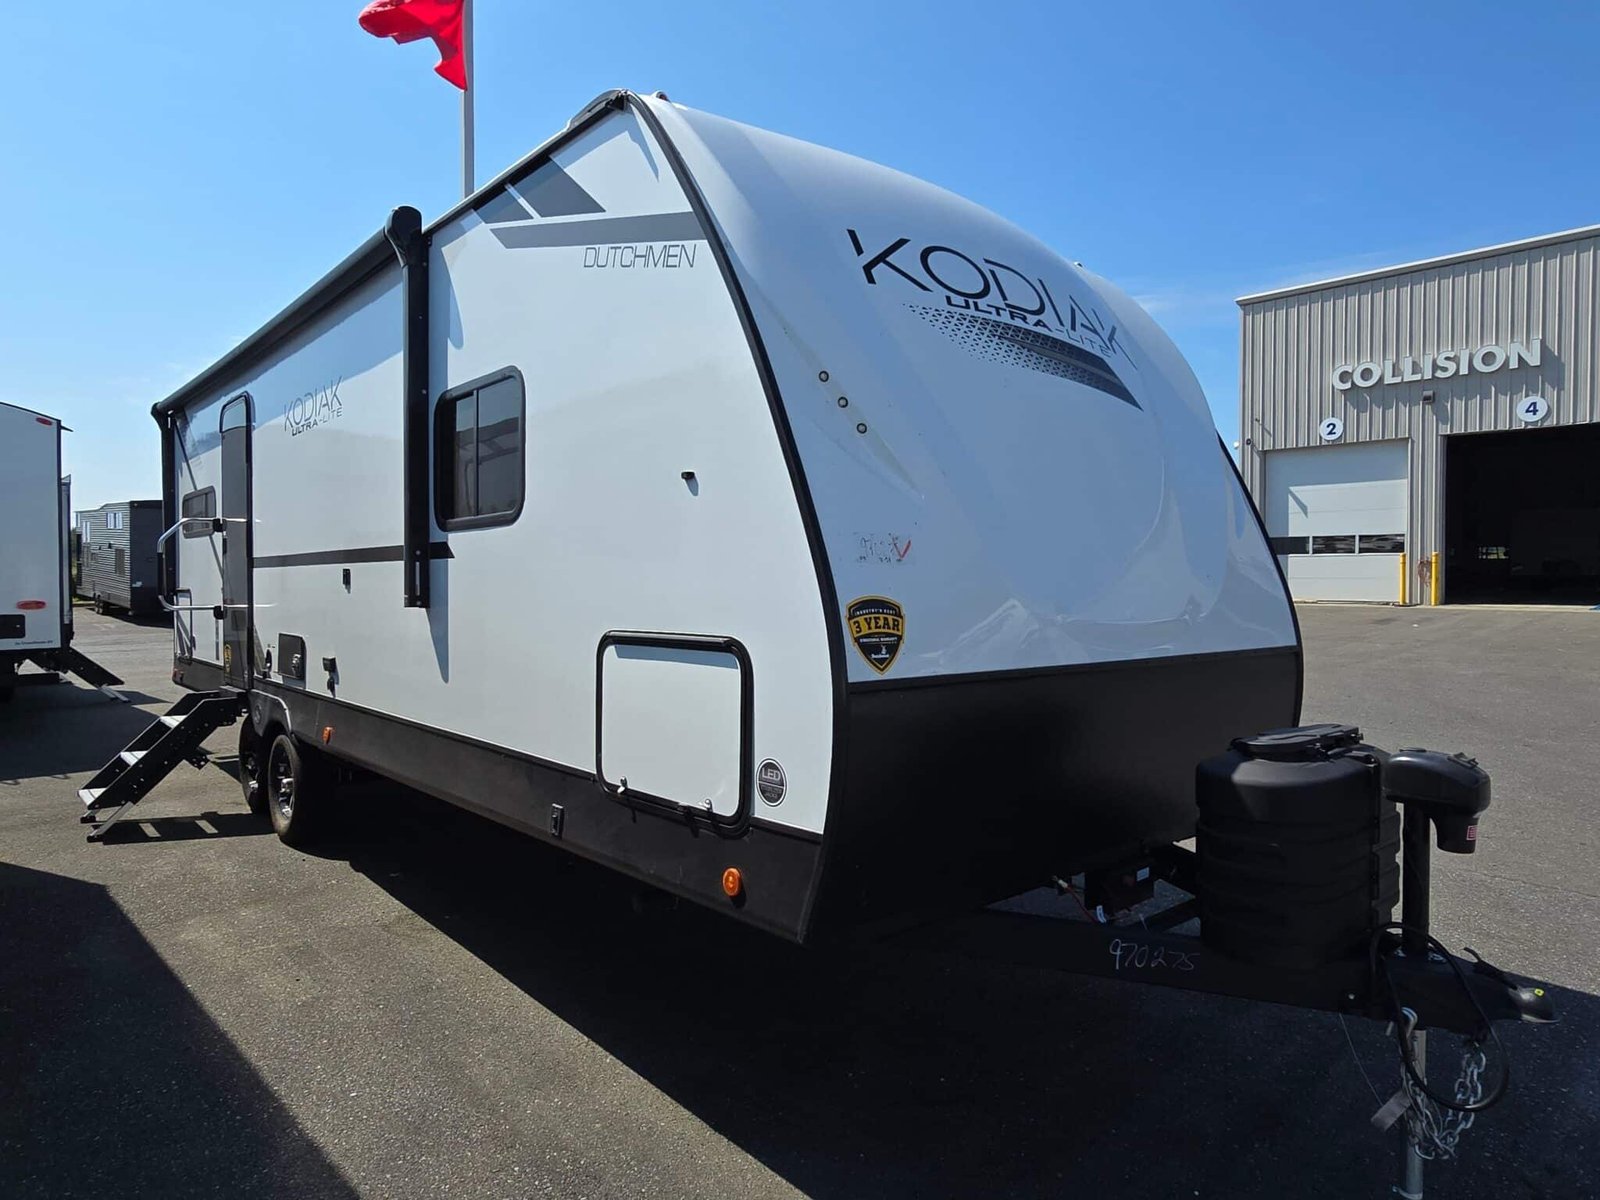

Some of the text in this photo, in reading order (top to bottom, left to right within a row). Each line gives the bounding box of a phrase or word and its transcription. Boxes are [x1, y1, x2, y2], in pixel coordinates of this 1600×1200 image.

[583, 244, 697, 268] DUTCHMEN
[846, 228, 1138, 370] KODIAK
[1332, 338, 1542, 391] COLLISION
[283, 375, 343, 432] KODIAK
[1525, 401, 1539, 416] 4
[1326, 422, 1337, 436] 2
[852, 616, 900, 634] 3 YEAR
[762, 767, 781, 781] LED
